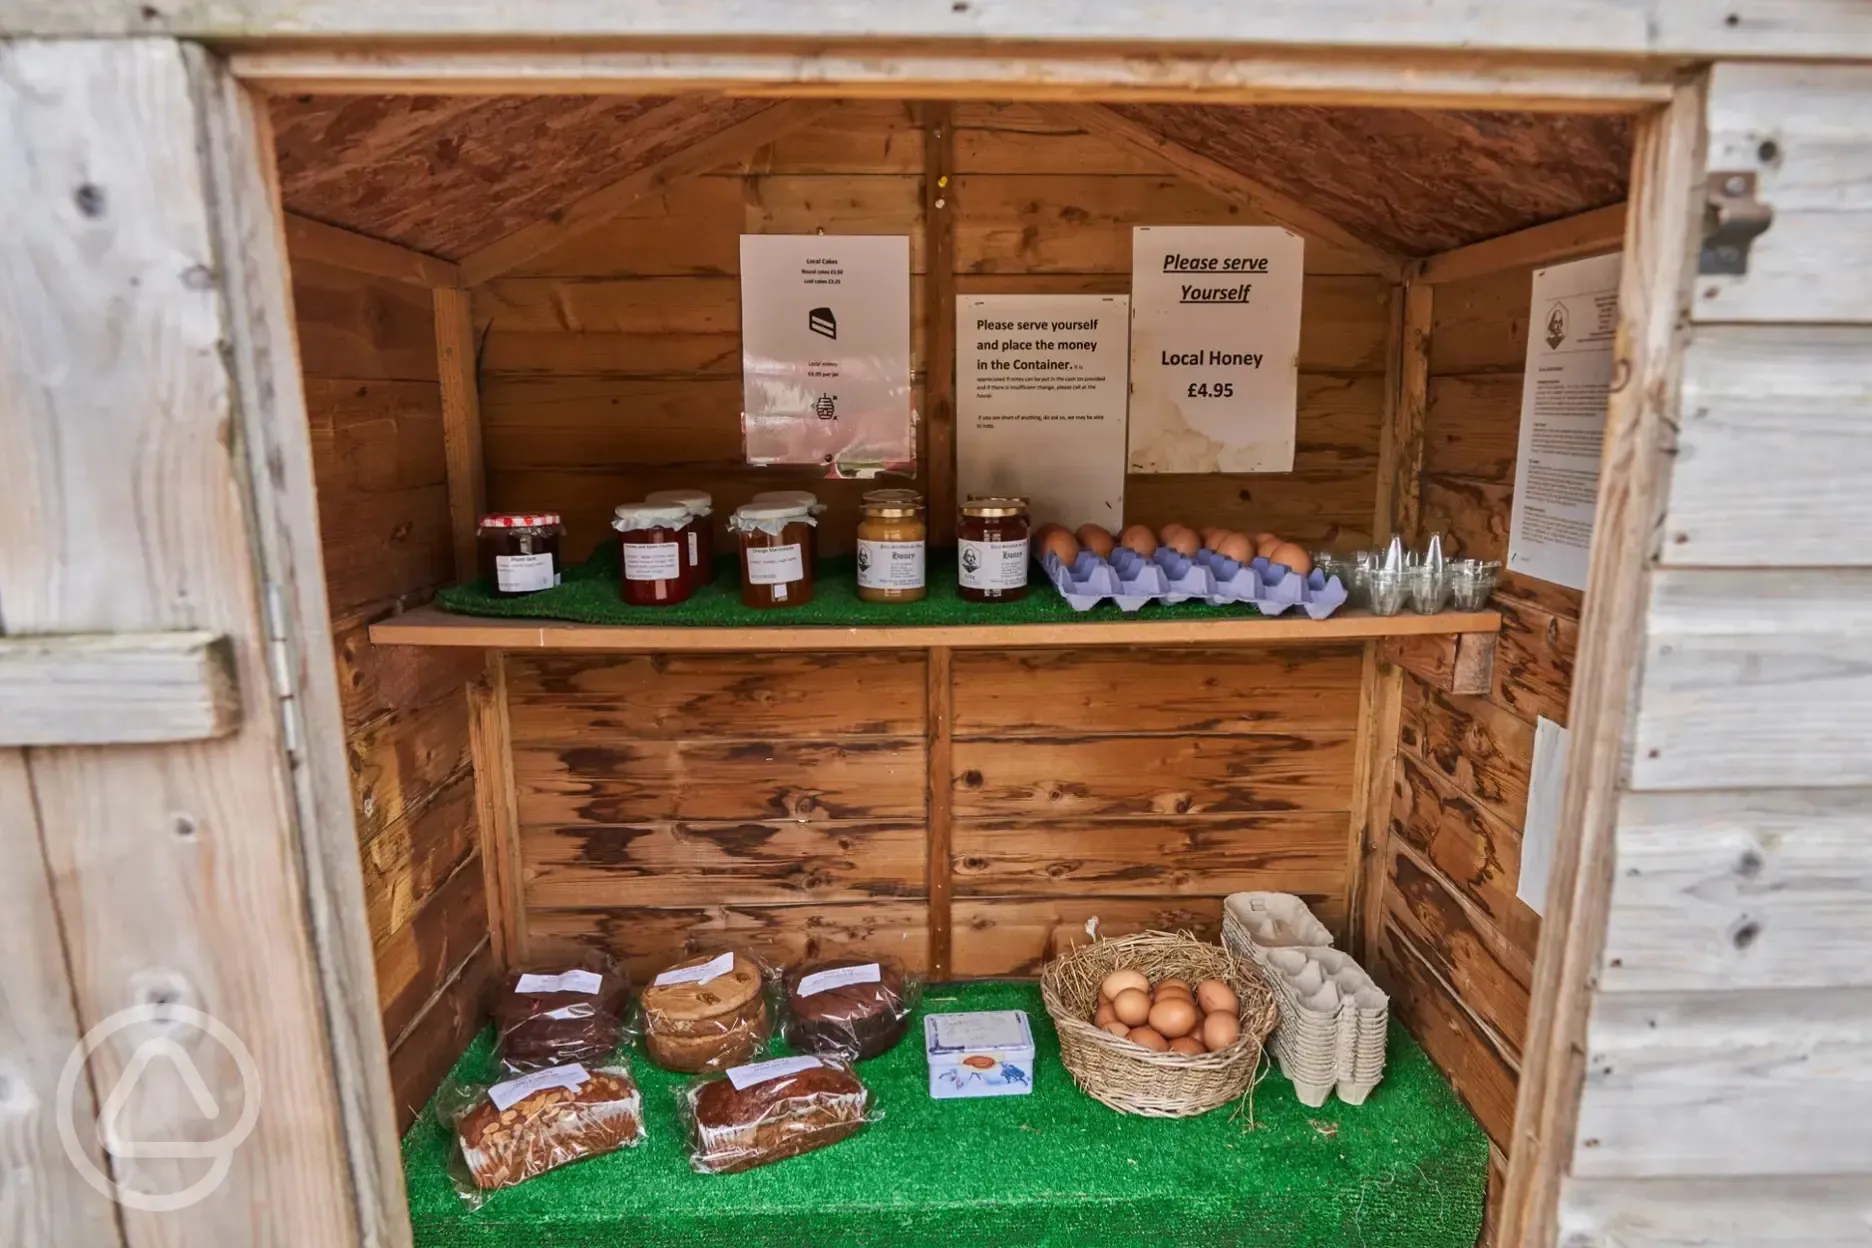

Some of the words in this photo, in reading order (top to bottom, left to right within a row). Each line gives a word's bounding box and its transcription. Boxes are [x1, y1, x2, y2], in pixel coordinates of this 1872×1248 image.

[1163, 254, 1218, 272] Please
[1222, 258, 1268, 272] serve
[1180, 284, 1252, 303] Yourself
[977, 319, 1014, 330] Please
[1017, 321, 1048, 330] serve
[1051, 319, 1099, 332] yourself
[977, 339, 999, 350] and
[1001, 339, 1032, 352] place
[1035, 339, 1054, 350] the
[1058, 341, 1097, 352] money
[977, 359, 988, 370] in
[991, 359, 1010, 370] the
[1013, 359, 1073, 370] Container.
[1161, 350, 1204, 365] Local
[1209, 351, 1263, 368] Honey
[1187, 383, 1233, 398] £4.95
